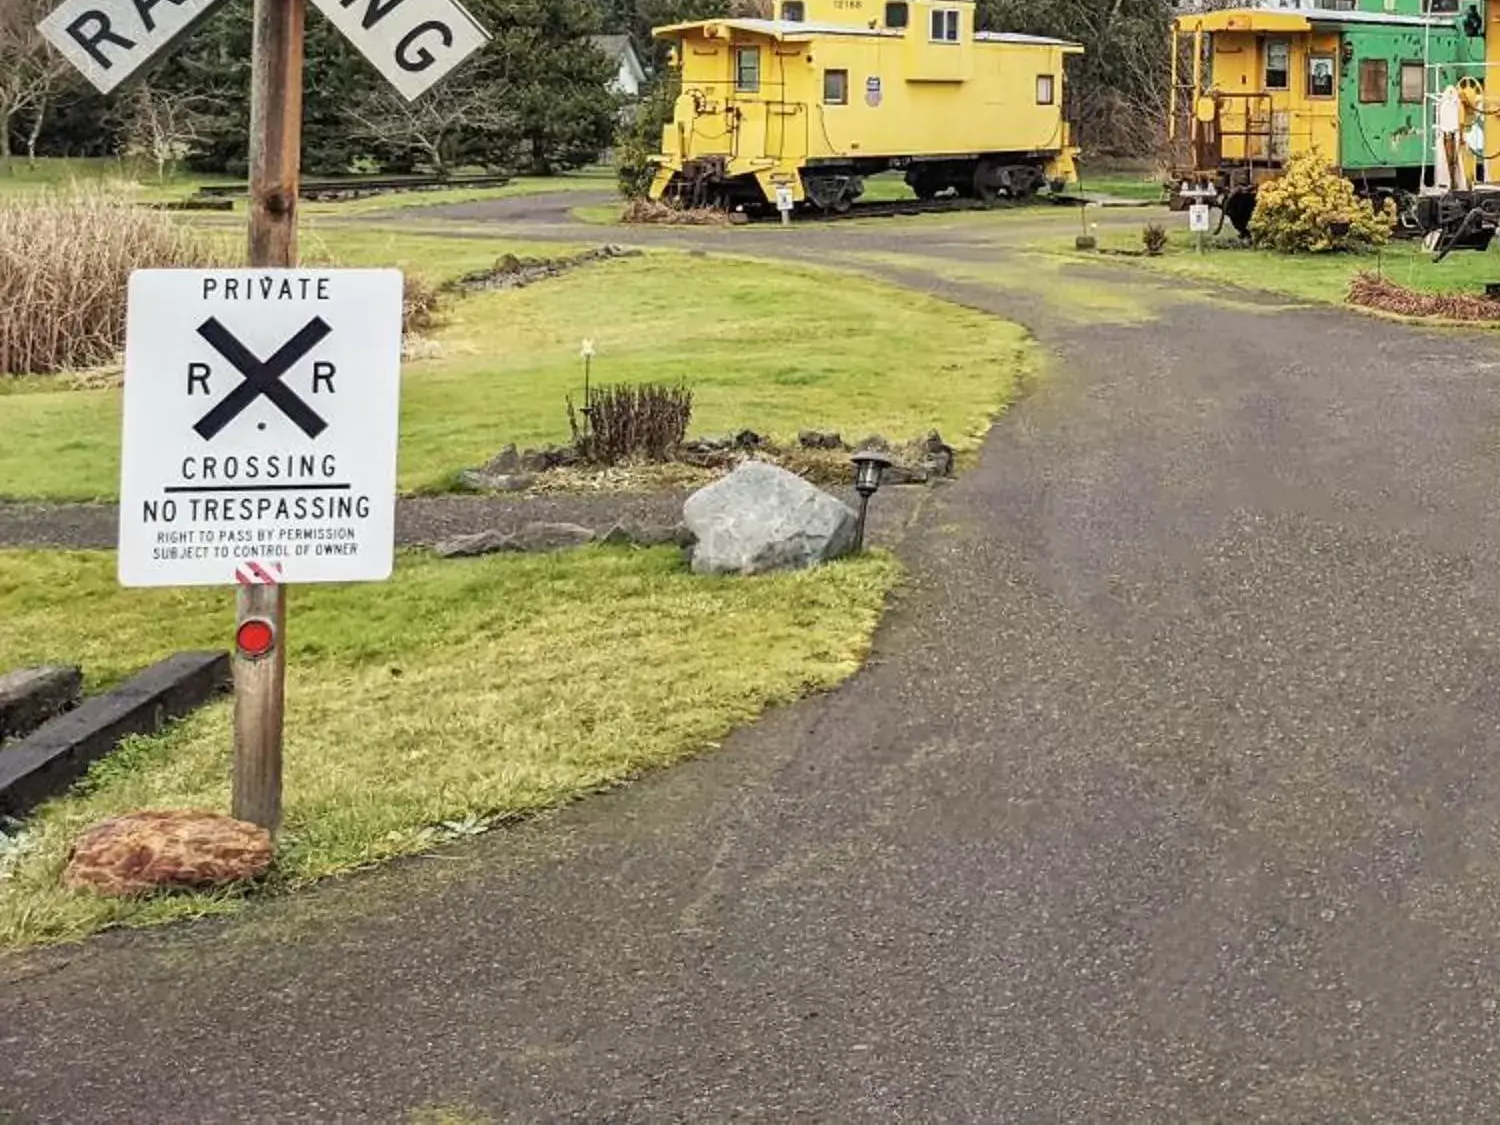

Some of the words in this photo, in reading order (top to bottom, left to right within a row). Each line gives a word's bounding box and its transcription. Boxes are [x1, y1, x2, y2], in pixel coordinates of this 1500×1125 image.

[203, 277, 331, 300] PRIVATE
[187, 362, 211, 396] R
[312, 361, 337, 394] R
[182, 454, 336, 480] CROSSING
[143, 499, 177, 523] NO
[190, 496, 370, 522] TRESPASSING
[157, 530, 195, 544] RIGHT
[200, 530, 215, 542] TO
[220, 530, 253, 543] PASS
[257, 529, 274, 541] BY
[279, 527, 355, 541] PERMISSION
[153, 546, 209, 559] SUBJECT
[215, 546, 229, 558] TO
[234, 544, 290, 557] CONTROL
[295, 543, 310, 556] OF
[315, 543, 359, 556] OWNER
